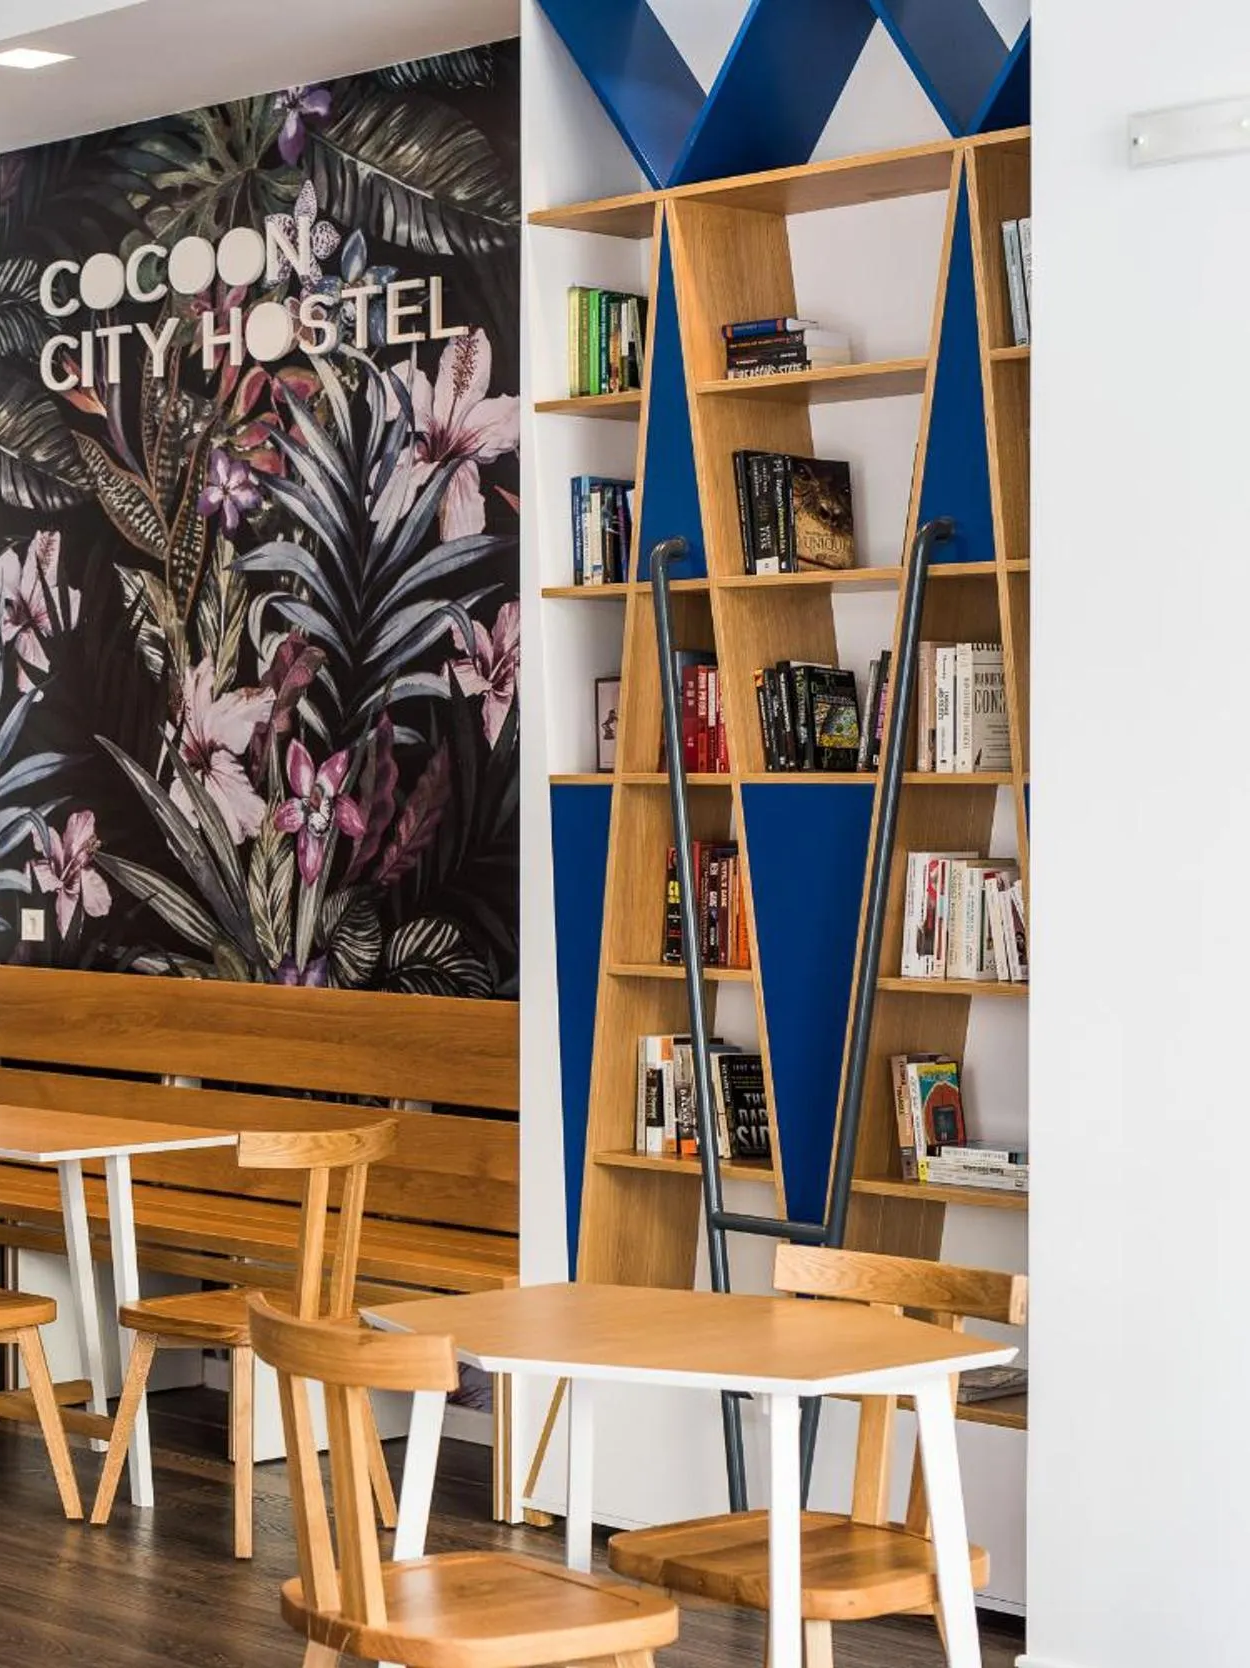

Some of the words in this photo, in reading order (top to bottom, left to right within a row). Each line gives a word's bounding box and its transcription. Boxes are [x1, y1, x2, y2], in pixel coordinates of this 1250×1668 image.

[39, 213, 310, 317] COCOON
[40, 317, 180, 391] CITY
[202, 275, 468, 371] HOSTEL
